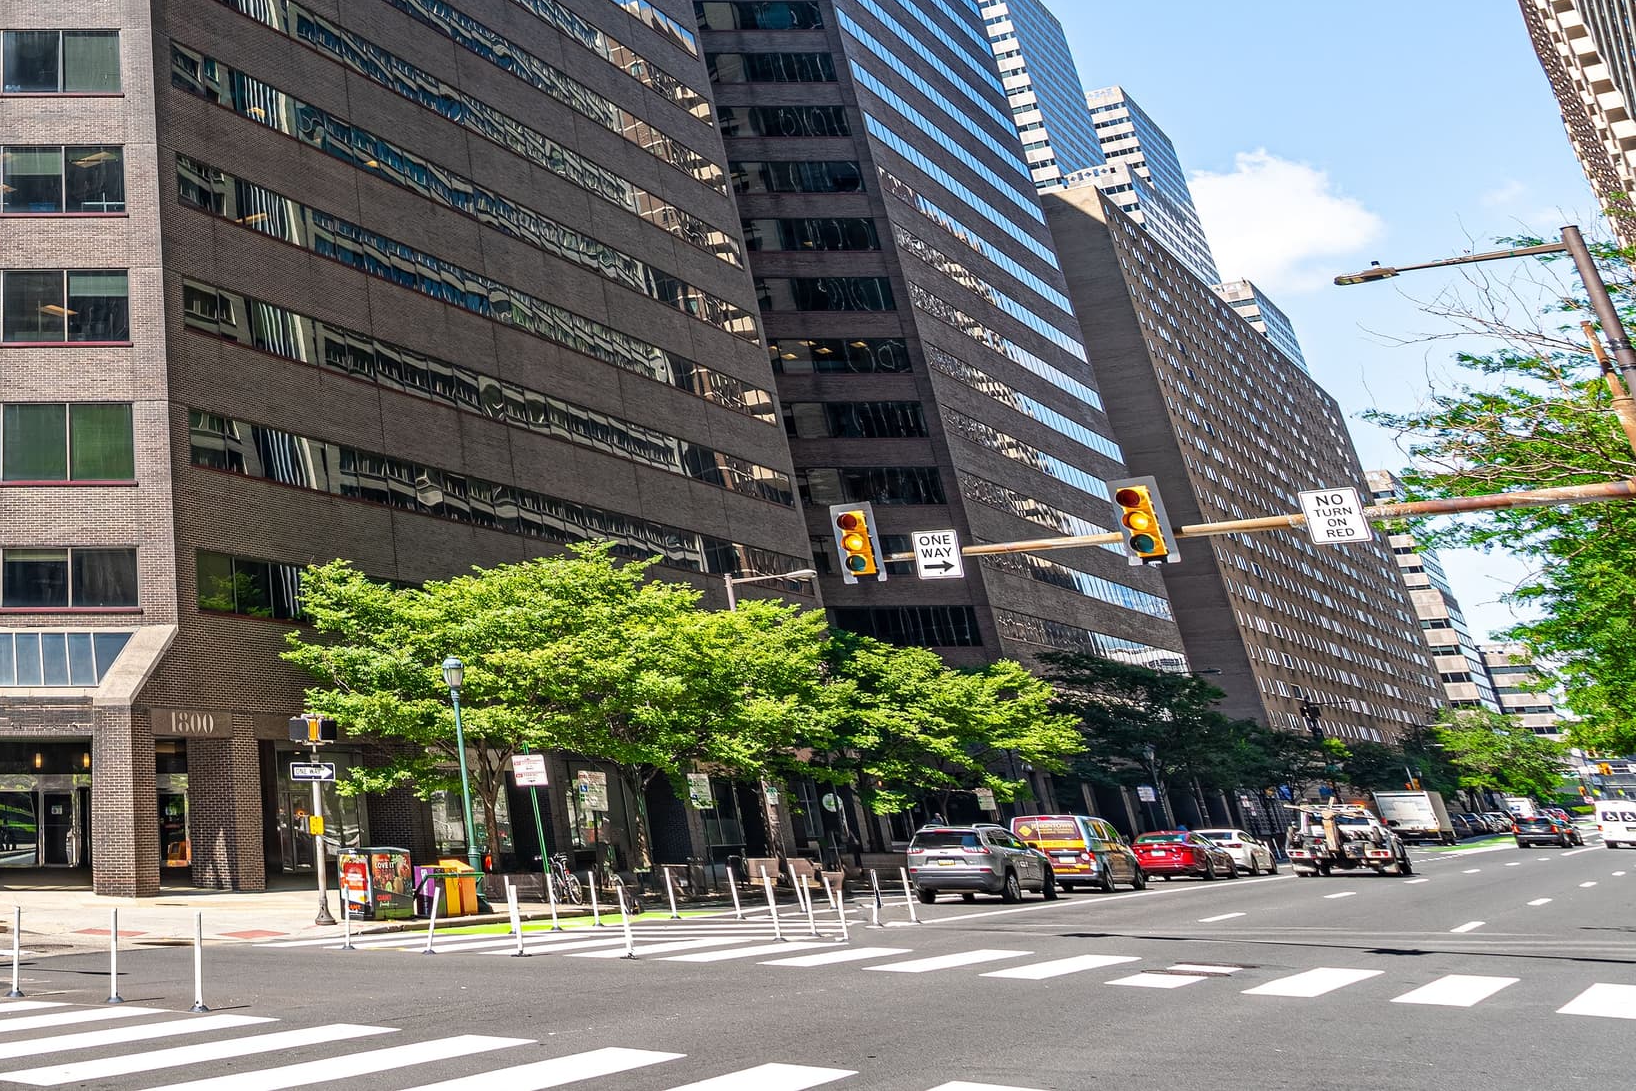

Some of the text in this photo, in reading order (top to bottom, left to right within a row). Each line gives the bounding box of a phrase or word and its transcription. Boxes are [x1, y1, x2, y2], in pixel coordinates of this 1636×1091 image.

[1316, 494, 1343, 506] NO
[1314, 507, 1352, 517] TURN
[1328, 518, 1347, 527] ON
[1326, 528, 1354, 537] RED
[920, 535, 951, 546] ONE
[921, 548, 951, 558] WAY
[172, 712, 214, 733] 1800
